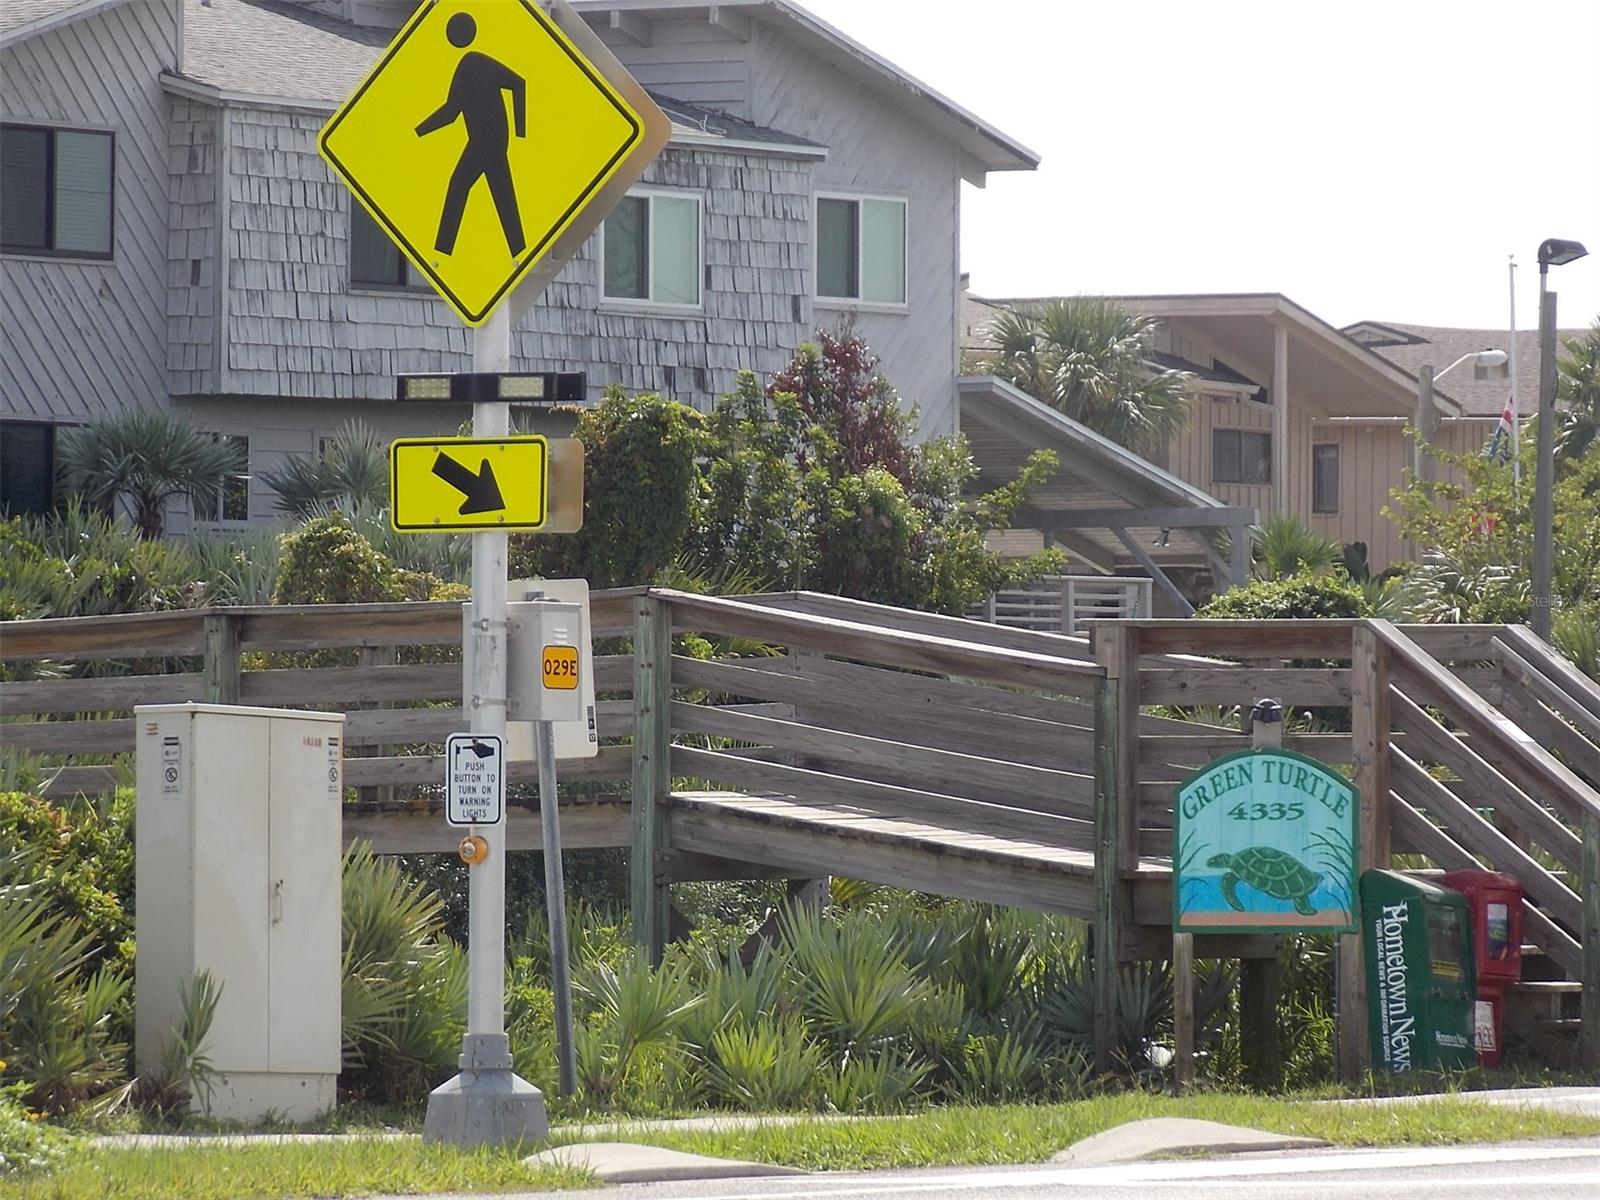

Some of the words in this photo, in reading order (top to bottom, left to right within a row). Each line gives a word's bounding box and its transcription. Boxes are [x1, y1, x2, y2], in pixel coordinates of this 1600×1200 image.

[544, 659, 577, 676] 029E
[465, 762, 485, 771] PUSH
[454, 774, 482, 783] BUTTON
[487, 774, 496, 783] TO
[458, 785, 477, 794] TURN
[481, 785, 492, 794] ON
[1182, 761, 1254, 820] GREEN
[1262, 760, 1349, 819] TURTLE
[458, 797, 491, 806] WARNING
[462, 809, 487, 818] LIGHTS
[1227, 801, 1305, 821] 4335
[1376, 938, 1385, 960] LOCAL
[1383, 901, 1409, 1016] Hometown
[1389, 1015, 1416, 1073] News
